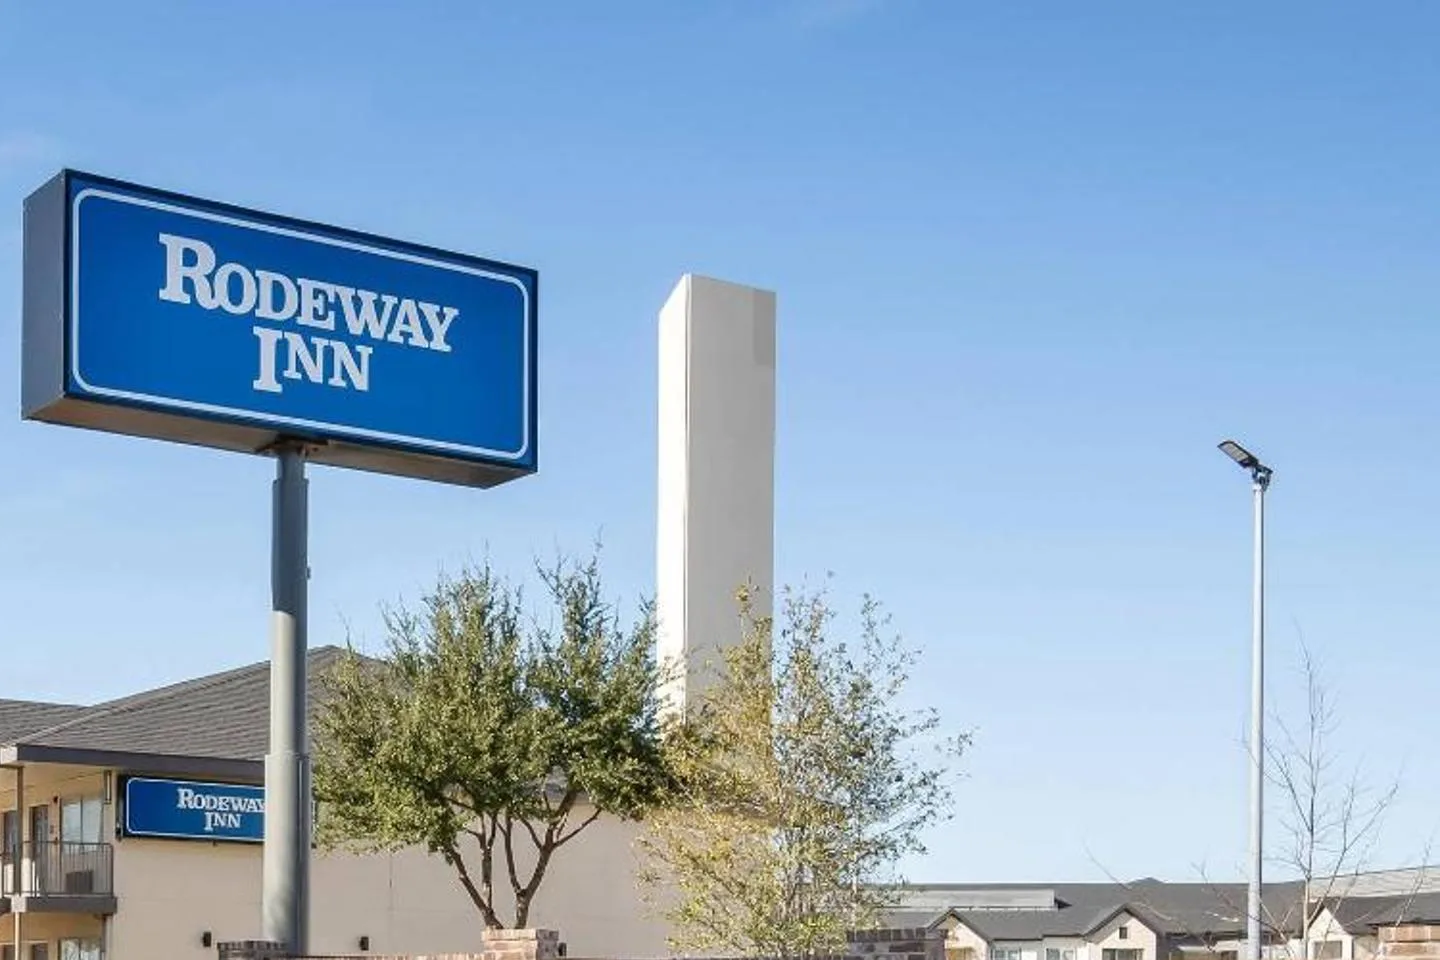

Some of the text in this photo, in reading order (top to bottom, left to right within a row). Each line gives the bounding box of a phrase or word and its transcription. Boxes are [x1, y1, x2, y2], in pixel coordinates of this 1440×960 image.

[158, 232, 459, 352] RODEWAY
[252, 326, 373, 393] INN
[203, 811, 242, 831] INN
